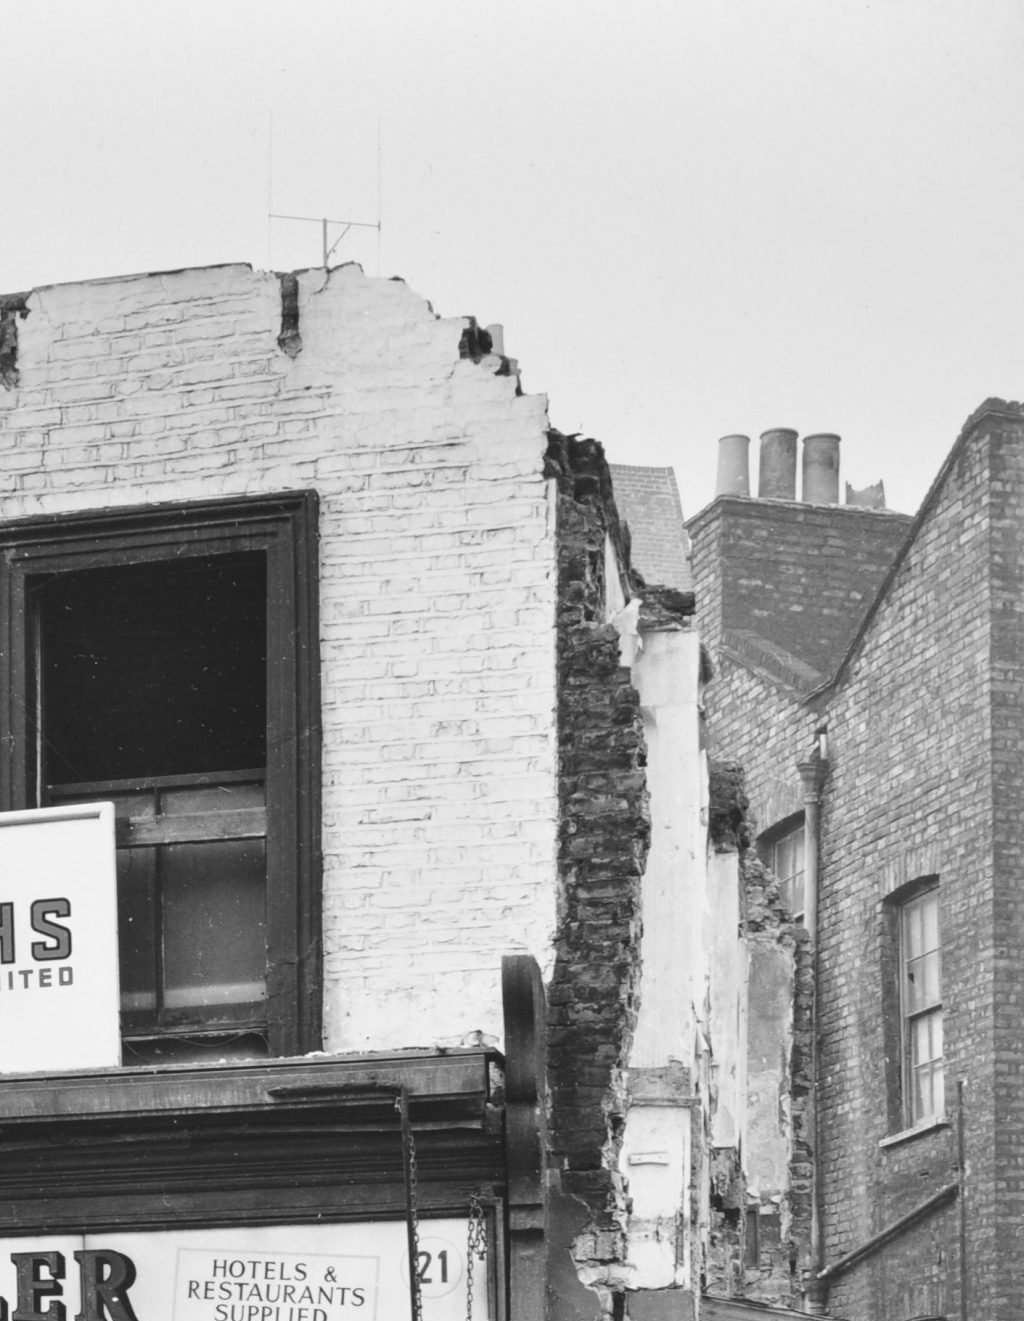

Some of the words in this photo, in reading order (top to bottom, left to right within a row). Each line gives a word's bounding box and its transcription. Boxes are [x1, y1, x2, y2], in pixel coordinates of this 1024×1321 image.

[213, 1259, 307, 1281] HOTELS
[324, 1266, 337, 1283] &
[417, 1250, 448, 1284] 21
[187, 1280, 365, 1307] RESTAURANTS
